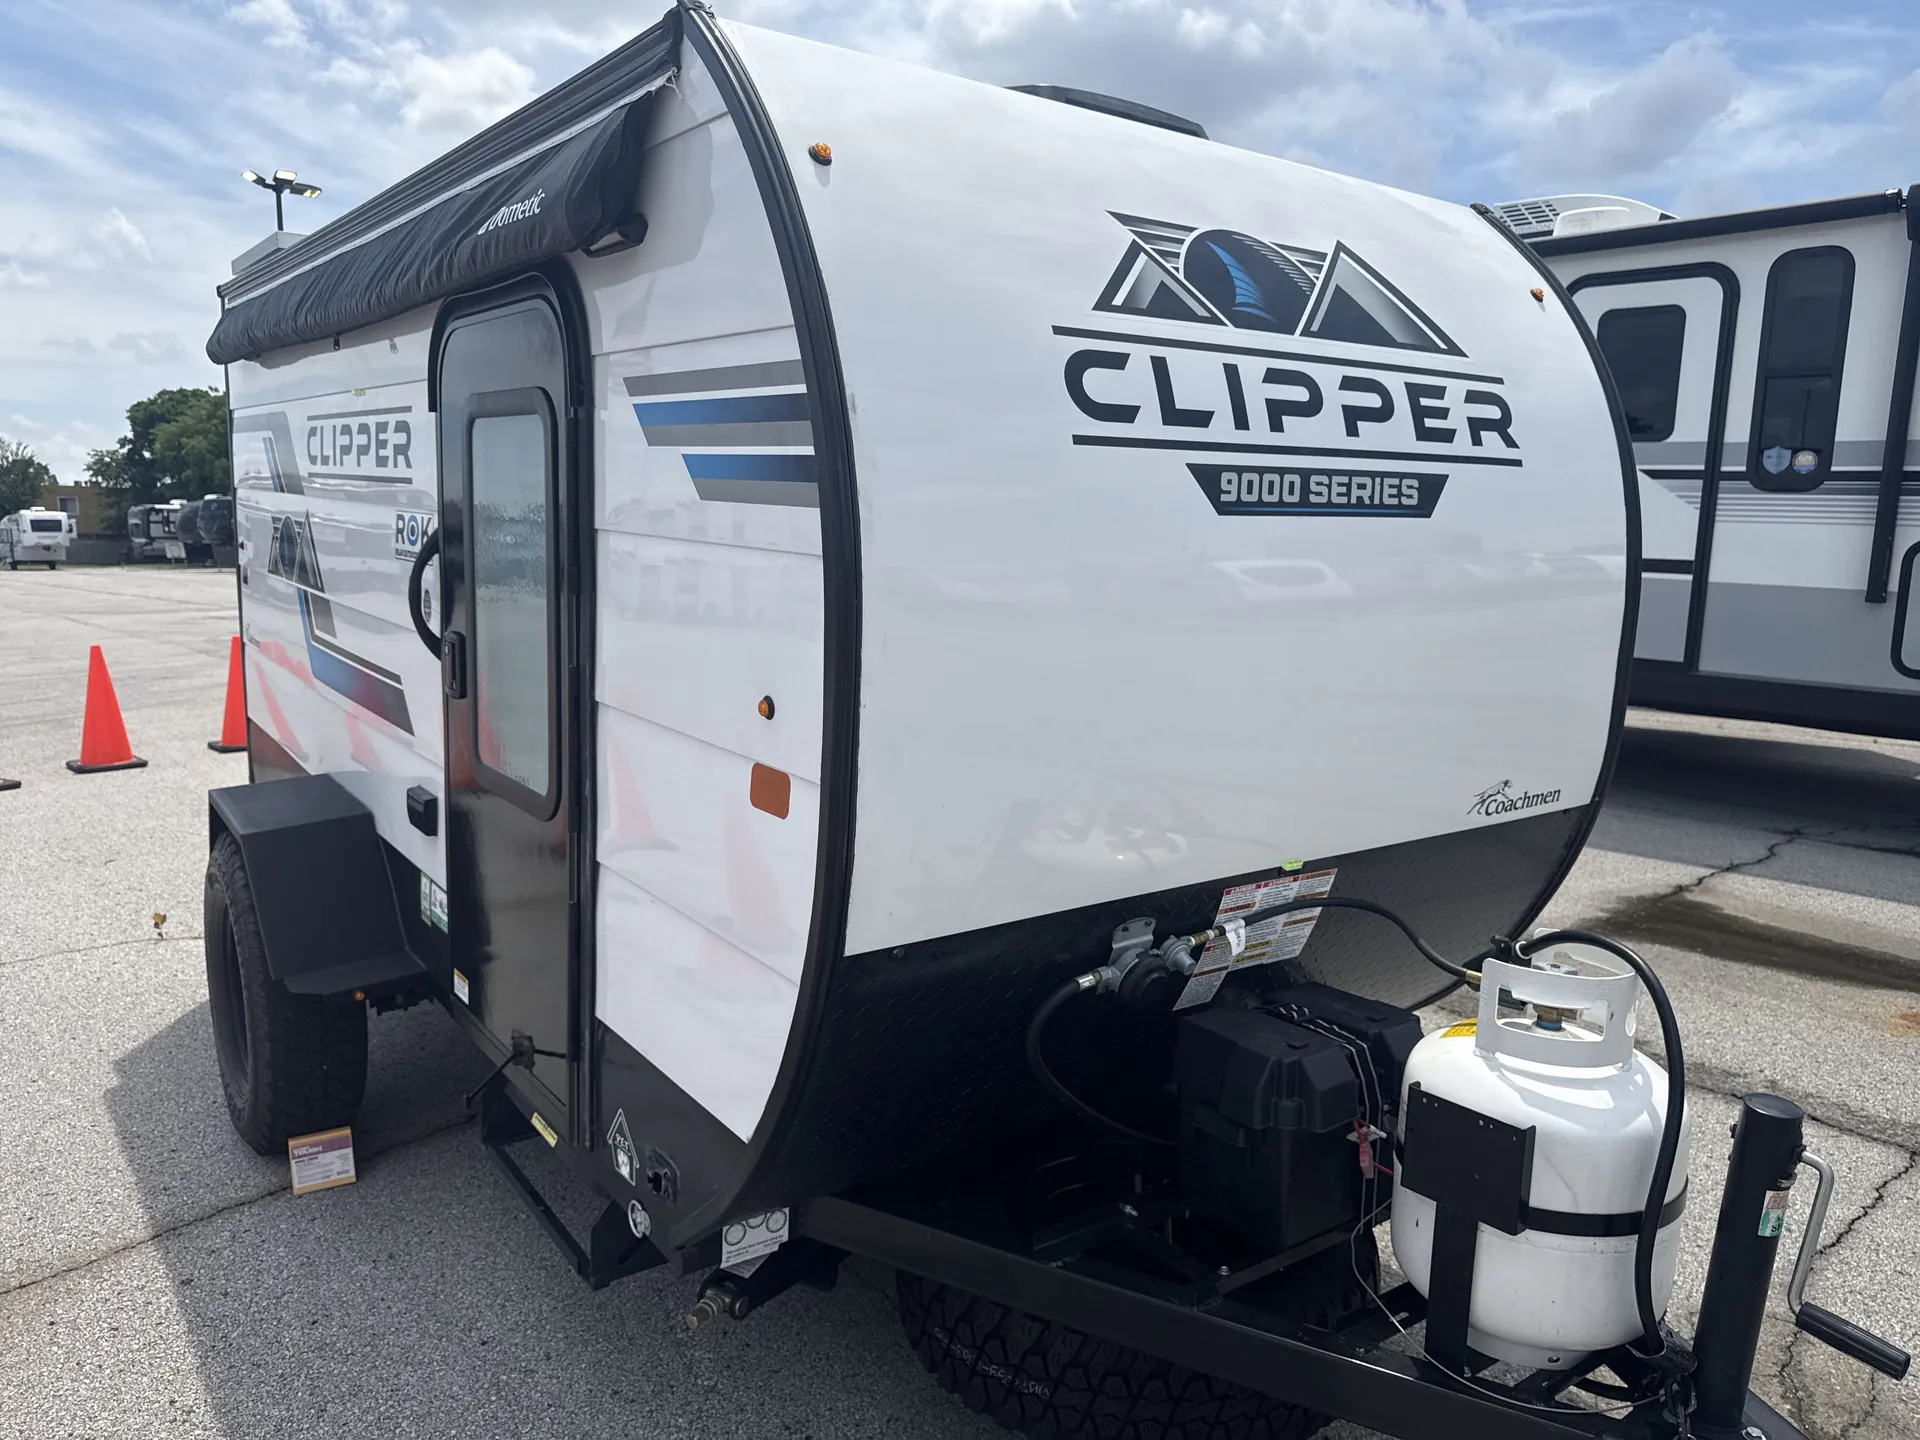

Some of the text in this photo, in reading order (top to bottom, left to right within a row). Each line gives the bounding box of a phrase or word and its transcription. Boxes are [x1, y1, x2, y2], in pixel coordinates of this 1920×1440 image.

[1064, 349, 1520, 449] CLIPPER
[307, 420, 412, 469] CLIPPER
[1220, 472, 1419, 506] 9000 SERIES
[396, 514, 433, 547] ROK
[1485, 789, 1561, 816] Coachmen
